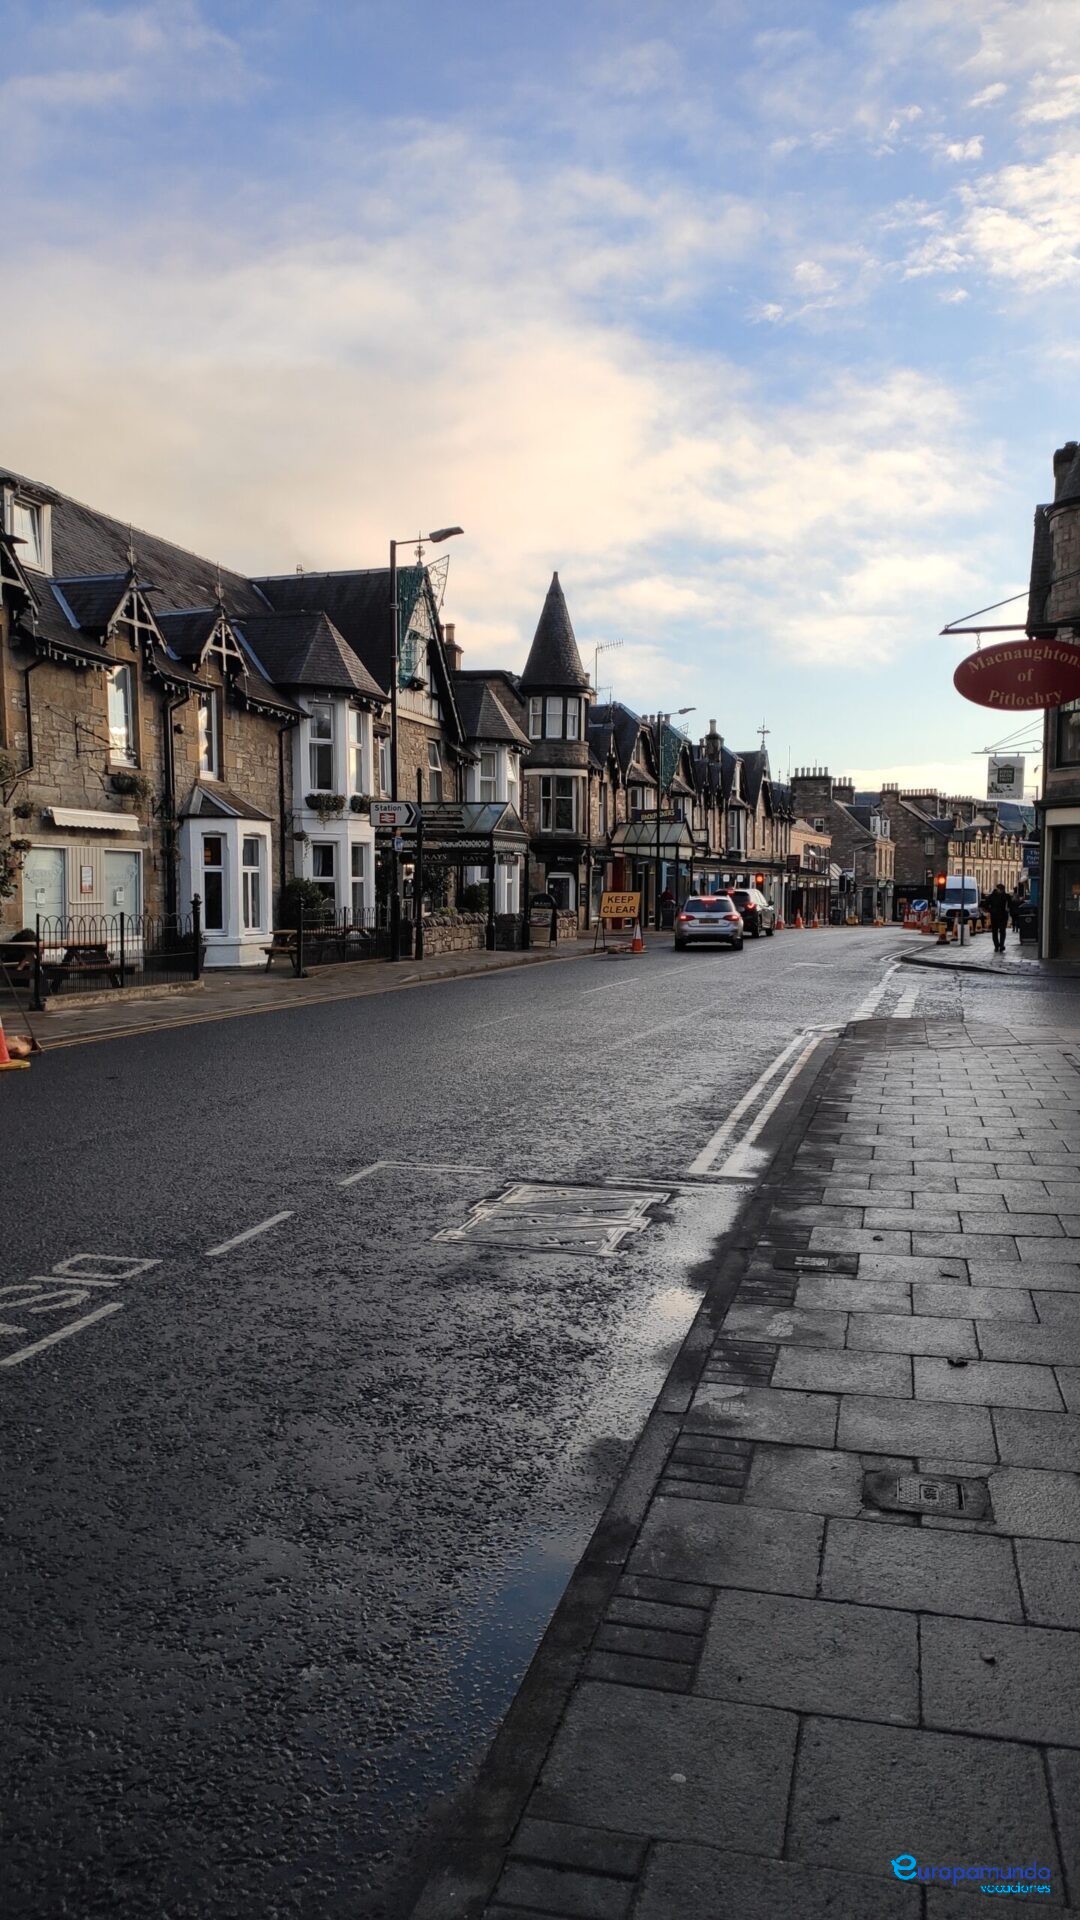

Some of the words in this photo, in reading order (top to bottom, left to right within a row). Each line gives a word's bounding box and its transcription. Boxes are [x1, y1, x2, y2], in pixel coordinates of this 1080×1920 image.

[1017, 668, 1034, 682] of
[988, 689, 1062, 706] Pitlochry
[375, 804, 402, 812] Station
[607, 895, 634, 904] KEEP
[602, 905, 636, 914] CLEAR
